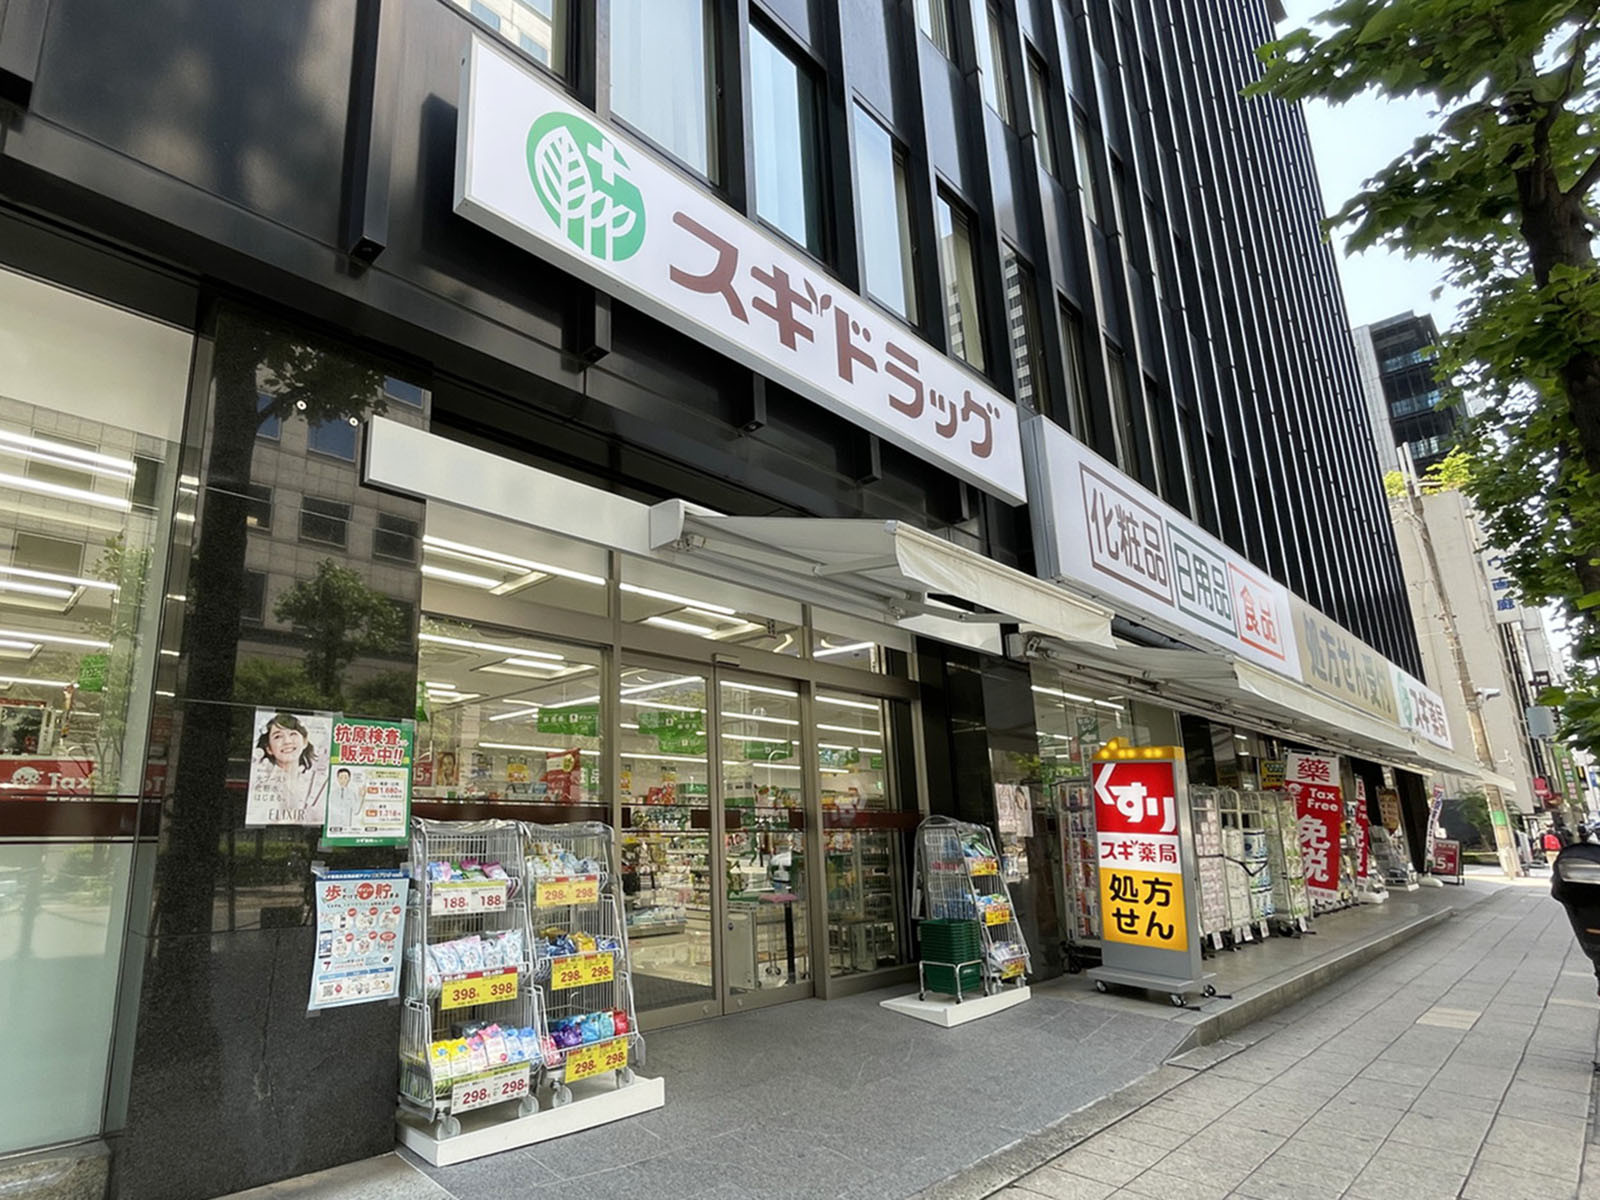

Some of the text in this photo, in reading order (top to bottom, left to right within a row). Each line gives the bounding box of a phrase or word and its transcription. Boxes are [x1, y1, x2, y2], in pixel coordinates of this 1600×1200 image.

[670, 211, 1000, 459] スギドラッグ
[1091, 488, 1277, 644] 化粧品 日用品 食品
[335, 724, 399, 745] 抗原検査
[48, 773, 90, 790] Tax
[1094, 763, 1177, 833] くすり
[1307, 798, 1339, 811] Free
[1309, 788, 1335, 800] Tax
[268, 807, 305, 820] ELIXIR
[1101, 839, 1178, 864] スギ薬局
[1109, 873, 1173, 907] 処方
[443, 895, 501, 909] 188 188
[1112, 906, 1174, 940] せん
[452, 982, 513, 1001] 398 398
[462, 1078, 525, 1104] 298 298
